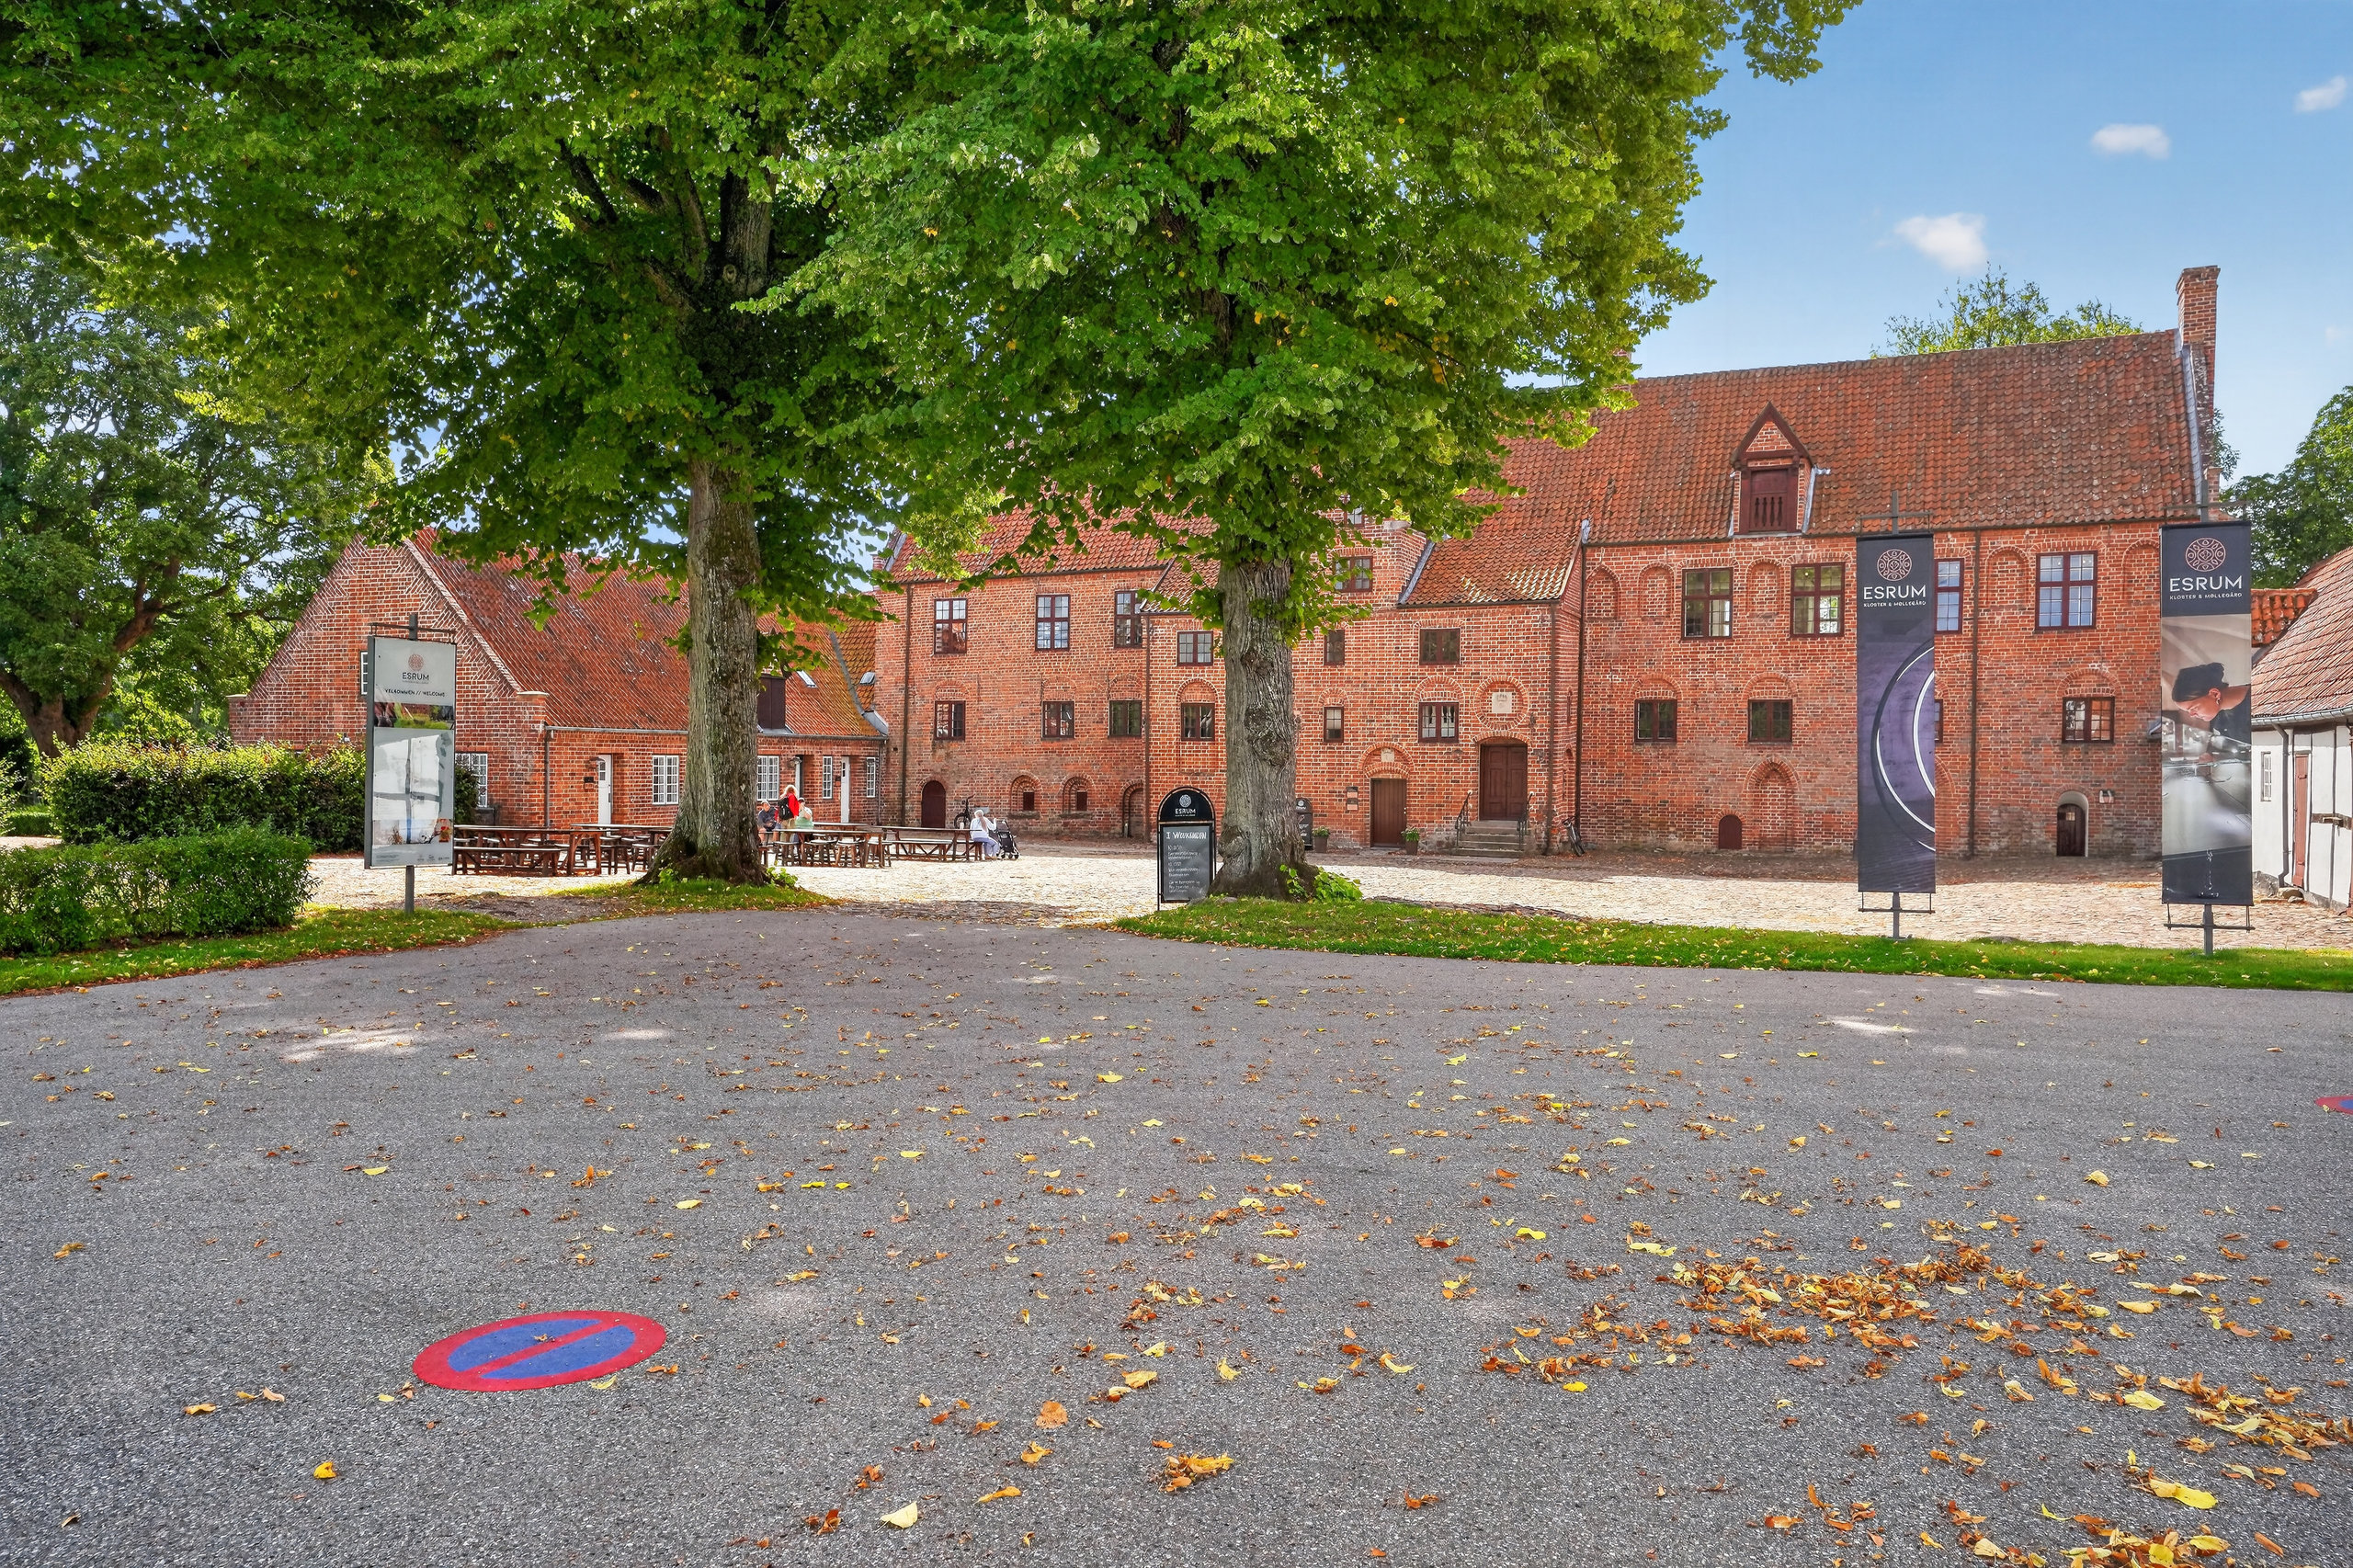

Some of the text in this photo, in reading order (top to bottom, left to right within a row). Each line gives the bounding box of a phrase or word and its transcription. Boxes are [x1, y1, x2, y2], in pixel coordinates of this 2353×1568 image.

[2169, 575, 2243, 592] ESRUM
[1863, 585, 1927, 600] ESRUM
[402, 672, 429, 680] ESRUM
